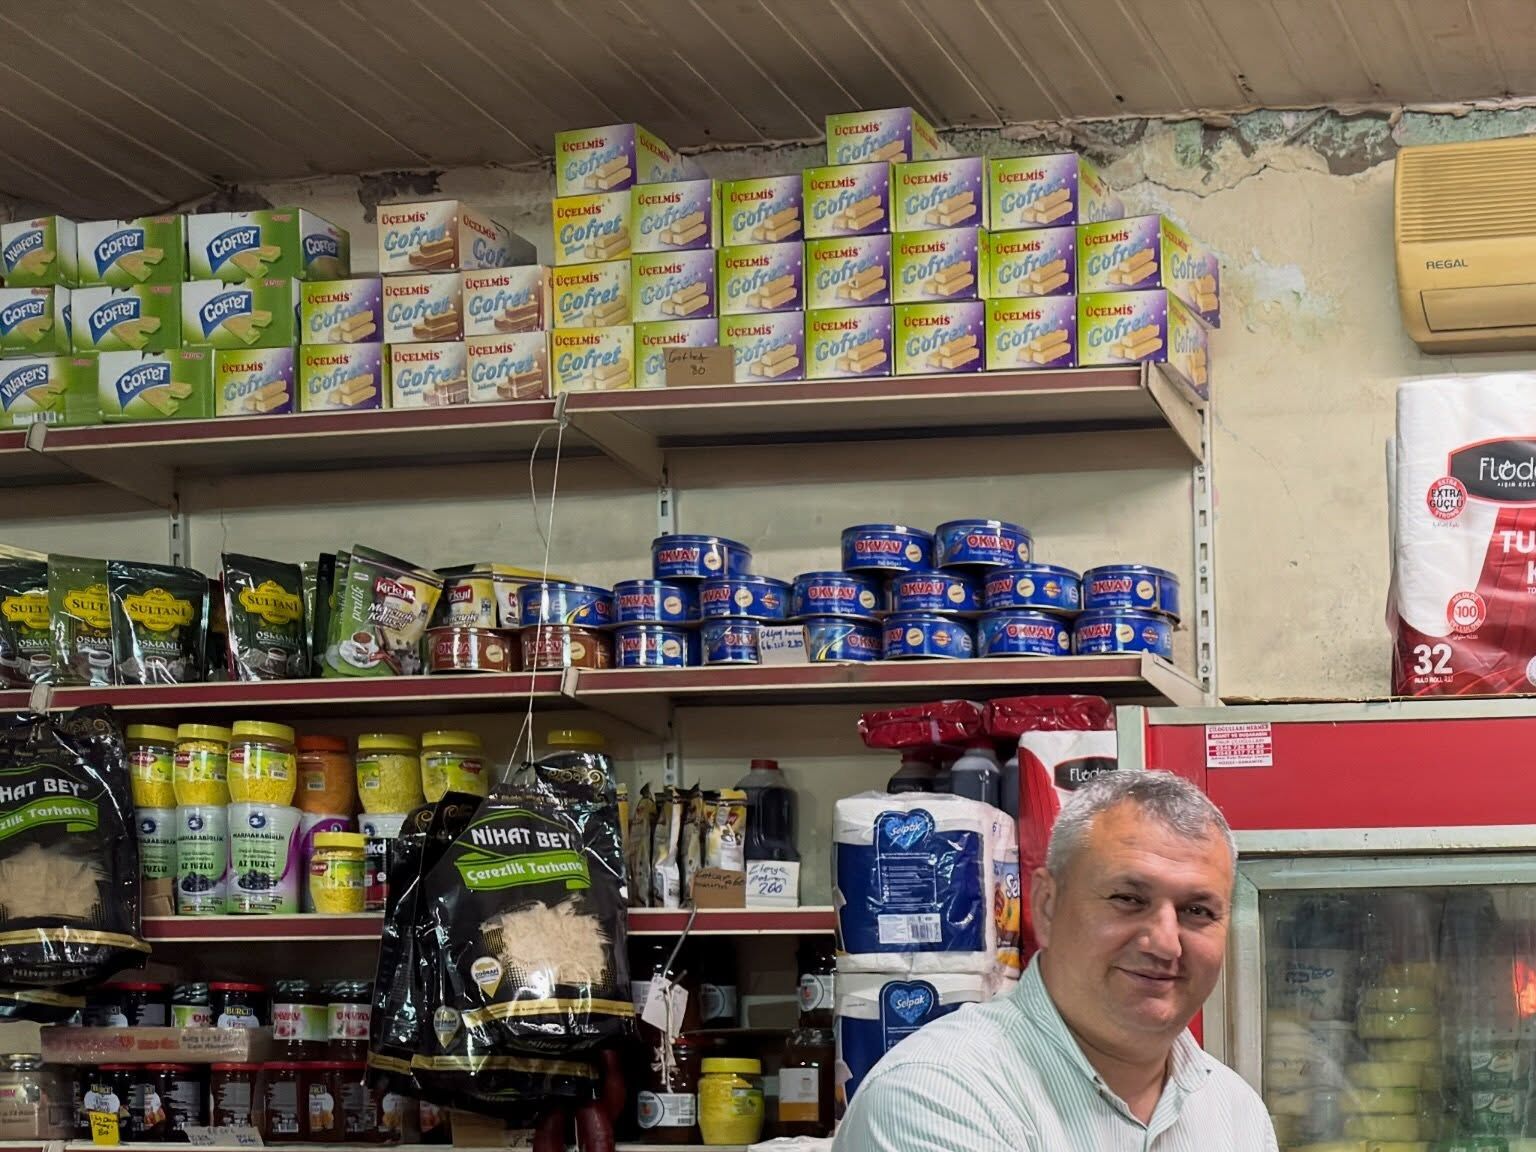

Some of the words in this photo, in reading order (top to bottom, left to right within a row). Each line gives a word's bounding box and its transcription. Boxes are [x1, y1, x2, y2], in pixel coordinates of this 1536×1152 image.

[560, 217, 621, 244] Gofret
[98, 233, 141, 259] Gofret
[210, 230, 258, 258] Gofret
[1426, 258, 1468, 270] REGAL
[203, 294, 249, 323] Gofret
[560, 287, 618, 312] Gofret
[93, 302, 137, 329] Gofret
[558, 347, 620, 372] Gofret
[120, 366, 166, 393] Gofret
[1432, 489, 1463, 498] EXTRA
[1456, 606, 1477, 617] 100
[1414, 644, 1453, 675] 32
[44, 779, 81, 796] BEY
[31, 806, 90, 817] Tarhana
[471, 826, 530, 845] NİHAT
[536, 832, 570, 848] BEY
[467, 862, 525, 884] Çerezlik
[528, 862, 583, 874] Tarhana
[896, 994, 925, 1010] Selpak
